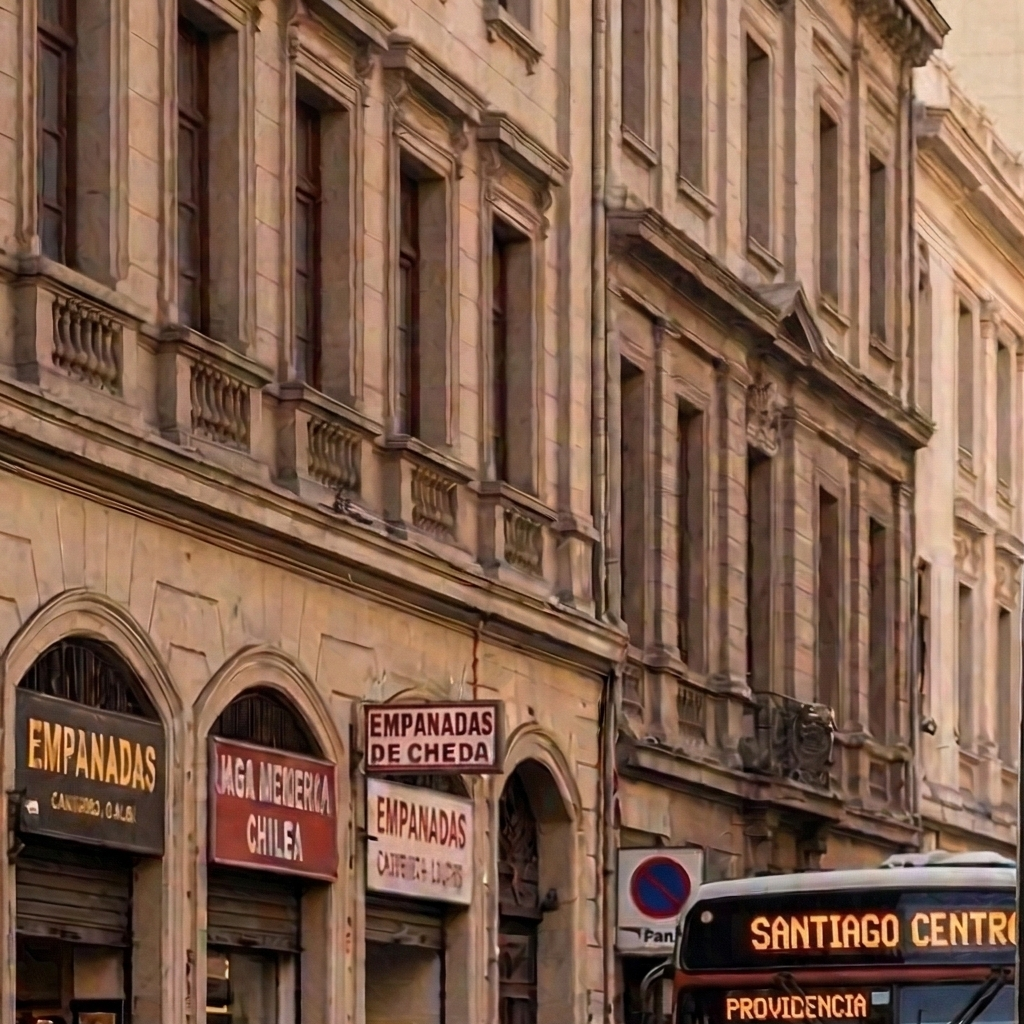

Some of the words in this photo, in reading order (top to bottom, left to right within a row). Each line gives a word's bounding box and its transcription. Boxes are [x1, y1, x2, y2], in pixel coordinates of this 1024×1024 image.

[370, 711, 493, 737] EMPANADAS
[28, 717, 157, 793] EMPANADAS
[371, 744, 400, 763] DE
[376, 796, 467, 849] EMPANADAS
[750, 913, 900, 950] SANTIAGO
[726, 993, 867, 1021] PROVIDENCIA
